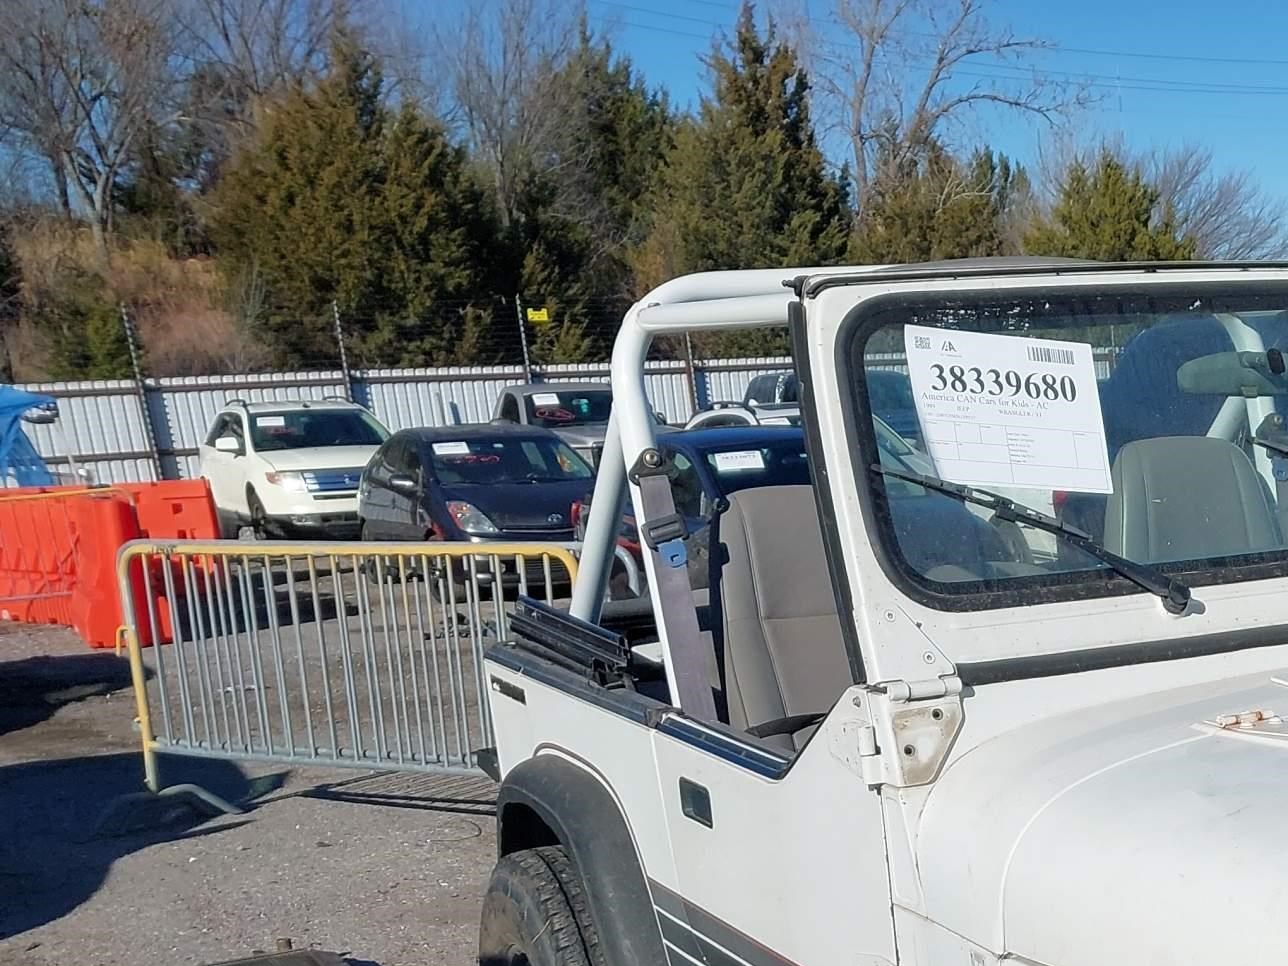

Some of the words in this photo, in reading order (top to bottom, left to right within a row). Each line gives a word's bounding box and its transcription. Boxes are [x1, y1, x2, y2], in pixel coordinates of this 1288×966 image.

[930, 364, 1077, 402] 38339680
[921, 391, 955, 402] America
[956, 393, 977, 404] CAN
[979, 396, 997, 406] Cars
[1011, 399, 1029, 408] Kids
